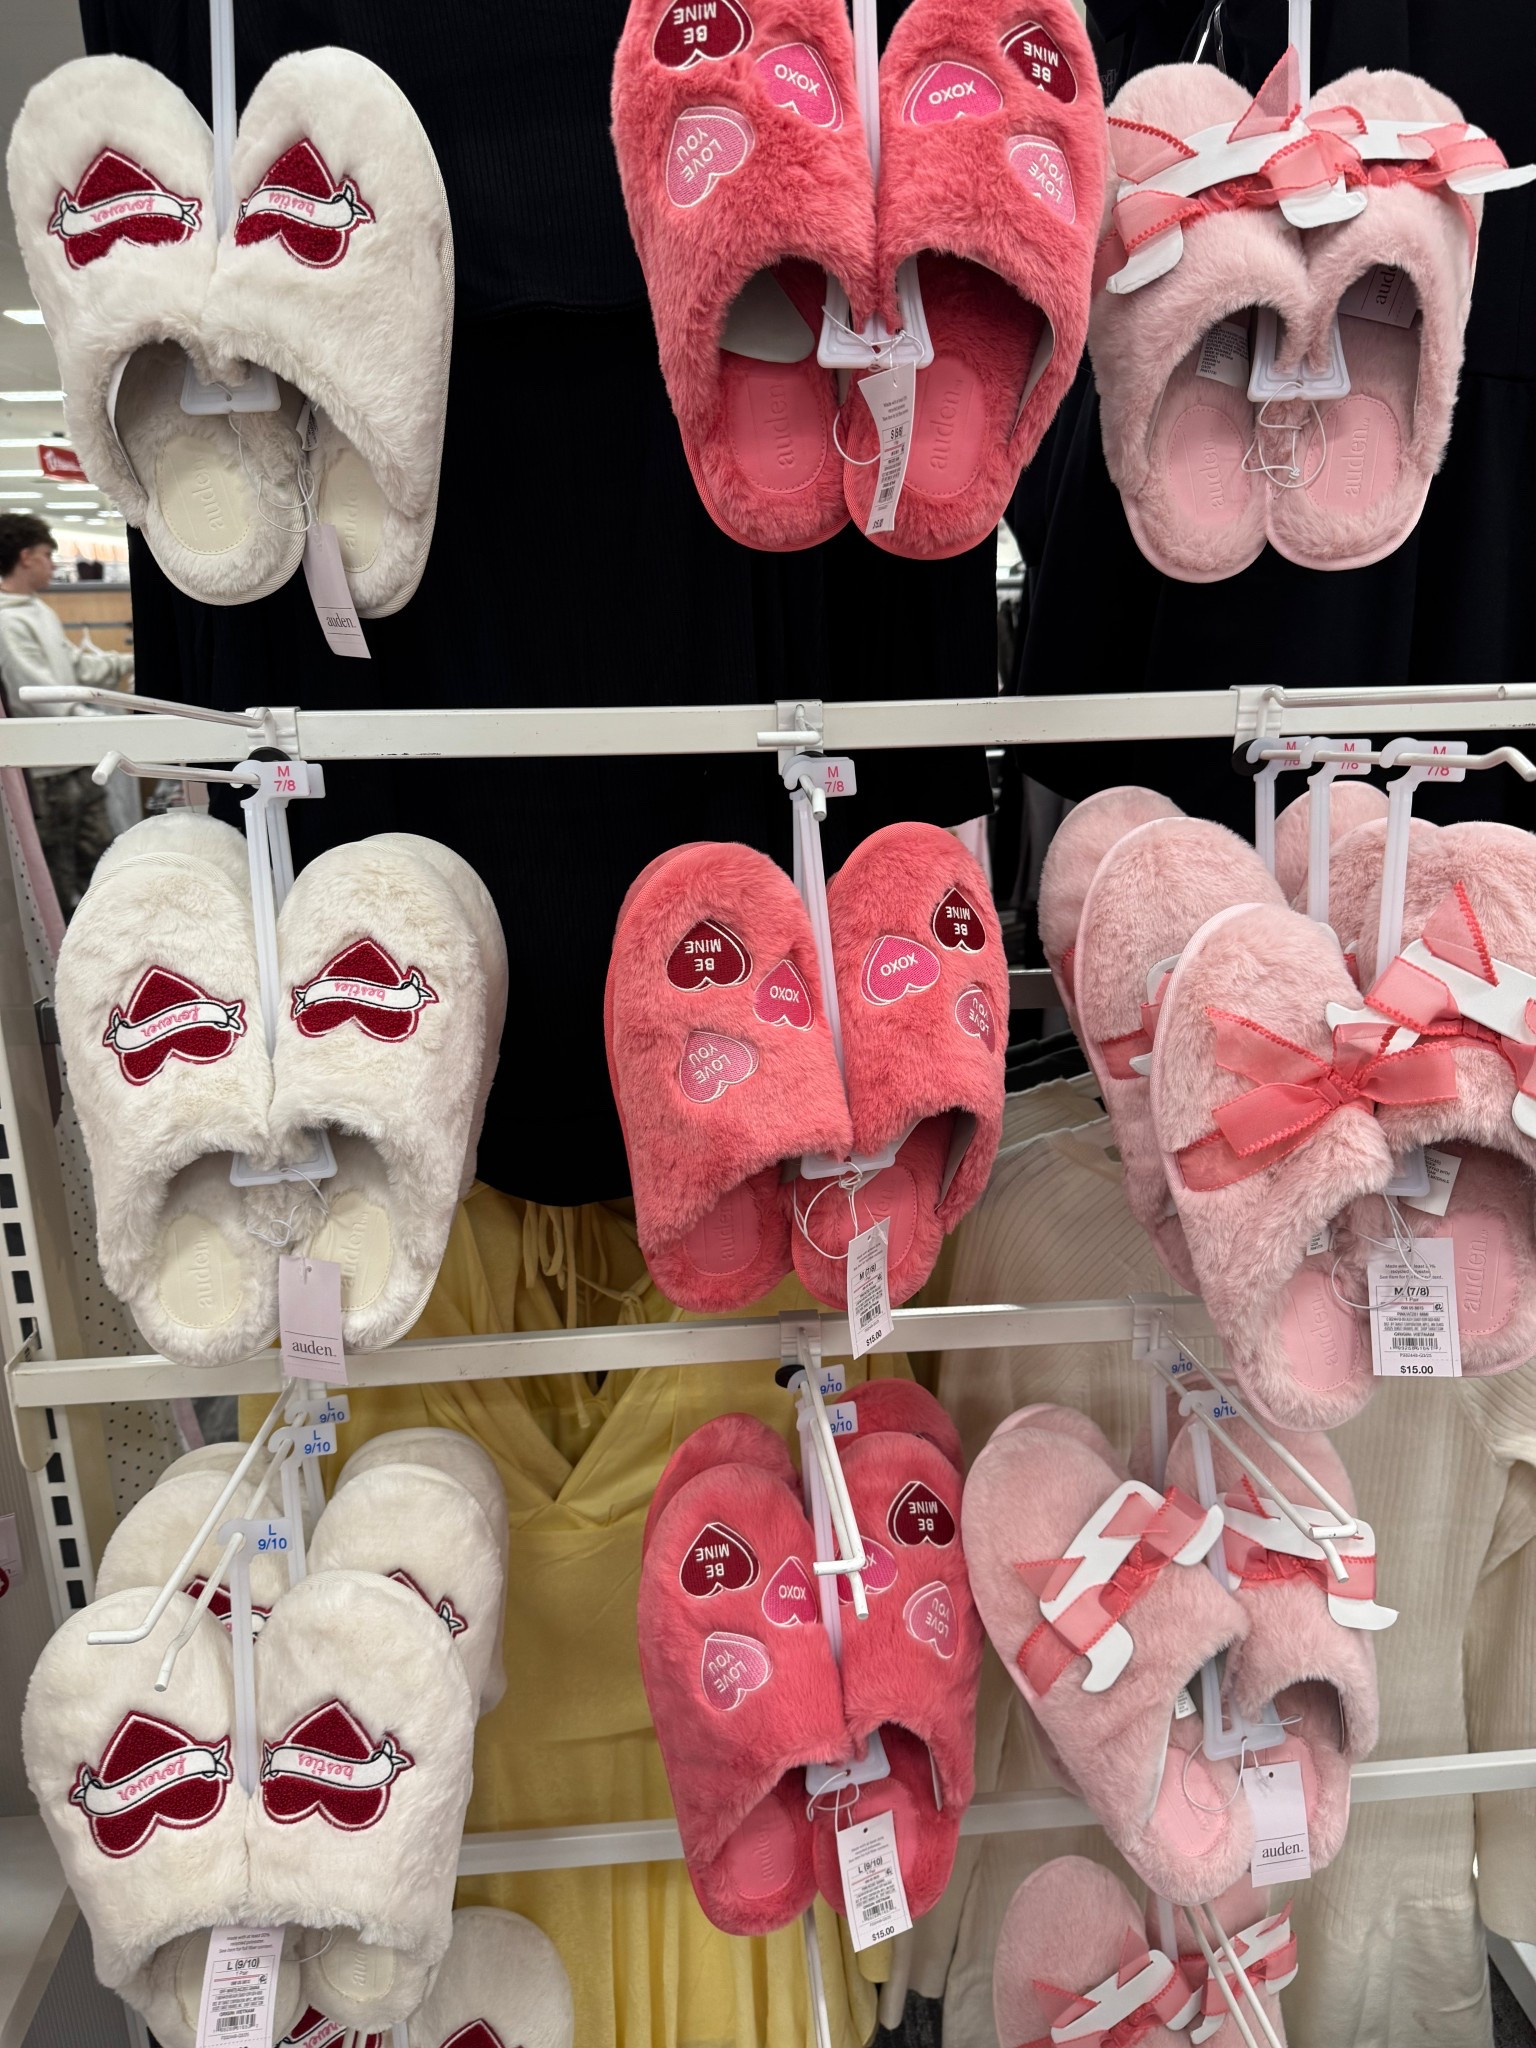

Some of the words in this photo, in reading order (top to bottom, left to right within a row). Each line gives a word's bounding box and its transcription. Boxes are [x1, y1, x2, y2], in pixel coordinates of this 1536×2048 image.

[673, 2, 717, 25] MINE
[683, 25, 708, 45] BE
[1023, 41, 1059, 68] MINE
[774, 63, 821, 97] XOXO
[1032, 62, 1052, 83] BE
[928, 79, 978, 105] XOXO
[676, 127, 709, 163] YOU
[681, 138, 724, 183] LOVE
[1038, 152, 1066, 189] YOU
[1028, 161, 1063, 203] LOVE
[90, 196, 157, 224] forever
[268, 191, 316, 218] besties
[1375, 264, 1398, 306] aude
[1286, 741, 1297, 750] M
[1344, 742, 1355, 752] M
[1432, 745, 1447, 755] M
[277, 765, 290, 777] M
[827, 766, 839, 778] M
[274, 780, 296, 792] 7/8
[824, 781, 845, 792] 7/8
[945, 906, 971, 921] MINE
[953, 922, 968, 936] BE
[684, 938, 722, 954] MINE
[694, 957, 715, 972] BE
[880, 952, 919, 977] XOXO
[334, 982, 386, 1001] besties
[769, 985, 800, 1004] XOXO
[972, 997, 989, 1022] YOU
[140, 1005, 201, 1037] forever
[968, 1008, 990, 1037] LOVE
[688, 1042, 719, 1067] YOU
[694, 1053, 732, 1084] LOVE
[1407, 1286, 1430, 1297] (7/8)
[866, 1329, 882, 1347] $15.00
[1180, 1352, 1186, 1361] L
[1171, 1361, 1193, 1374] 9/10
[1400, 1365, 1433, 1375] $15.00
[828, 1373, 834, 1382] L
[820, 1382, 842, 1395] 9/10
[327, 1402, 335, 1411] L
[1220, 1395, 1228, 1404] L
[319, 1411, 345, 1423] 9/10
[837, 1409, 844, 1419] L
[313, 1430, 321, 1440] L
[830, 1420, 853, 1434] 9/10
[304, 1441, 331, 1455] 9/10
[908, 1501, 938, 1515] MINE
[268, 1524, 277, 1536] L
[918, 1518, 935, 1531] BE
[258, 1537, 288, 1551] 9/10
[695, 1543, 730, 1562] MINE
[705, 1562, 725, 1579] BE
[778, 1584, 807, 1600] XOXO
[931, 1597, 950, 1622] YOU
[925, 1611, 949, 1638] LOVE
[708, 1650, 736, 1676] YOU
[714, 1660, 748, 1693] LOVE
[297, 1752, 355, 1781] besties
[116, 1754, 187, 1801] forever
[863, 1856, 883, 1871] (9/10)
[871, 1925, 895, 1942] $15.00
[226, 1961, 233, 1971] L
[234, 1957, 260, 1971] (9/10)
